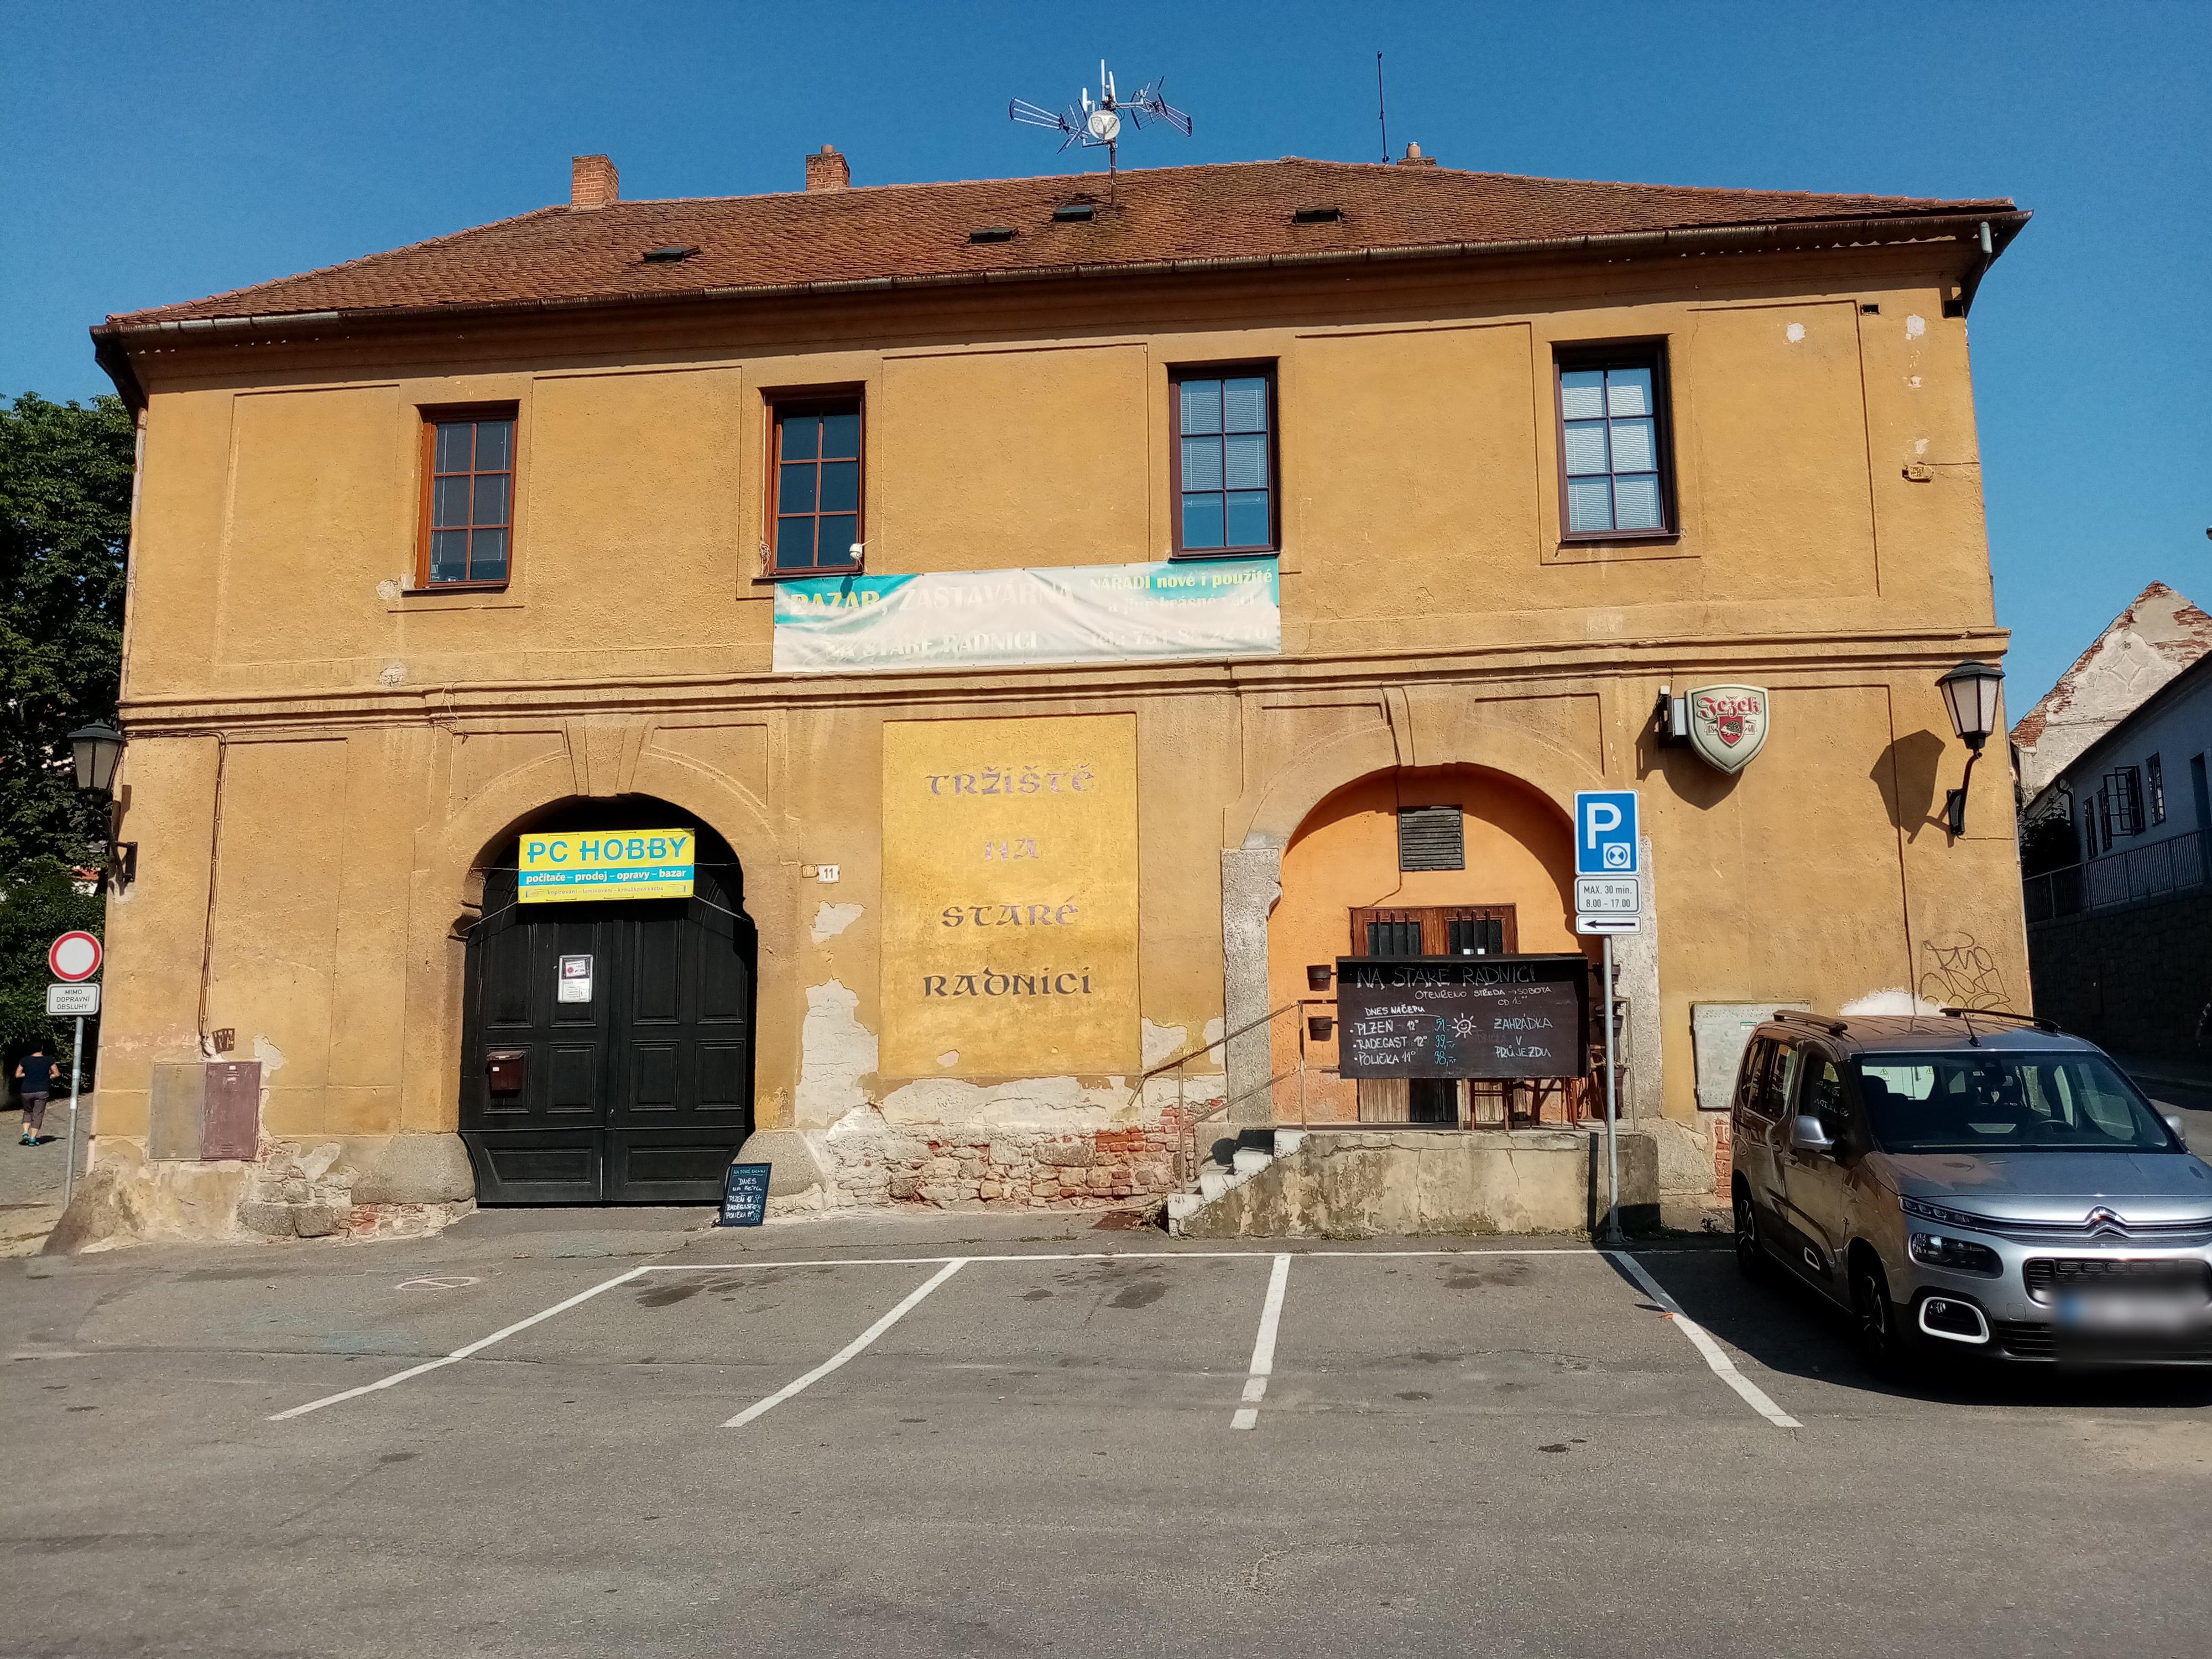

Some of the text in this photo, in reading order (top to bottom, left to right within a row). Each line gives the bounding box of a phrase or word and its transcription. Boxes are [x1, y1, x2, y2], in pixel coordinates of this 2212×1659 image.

[1090, 569, 1272, 590] NÁŘADÍ nové i použité
[1243, 624, 1268, 640] 70
[943, 631, 1037, 653] RADNICI
[1697, 695, 1761, 720] Ježek
[924, 763, 1095, 795] TRŽIŠTĚ
[1587, 803, 1622, 849] P
[528, 837, 686, 863] PC HOBBY
[985, 839, 1039, 860] NA
[526, 872, 566, 884] počítače
[575, 871, 607, 882] prodej
[617, 870, 650, 881] opravy
[659, 869, 686, 878] bazar
[824, 868, 833, 879] 11
[1584, 885, 1632, 894] MAX. 30 min.
[941, 896, 1078, 927] STARÉ
[1586, 899, 1601, 907] 8.00
[1611, 899, 1630, 907] 17.00
[924, 966, 1093, 997] RADNICI
[1357, 964, 1536, 990] NA STARÉ RADNICI
[1474, 988, 1505, 997] STŘEDA
[1517, 986, 1552, 995] SOBOTA
[1364, 1006, 1388, 1016] DNES
[1354, 1019, 1394, 1036] PLZEŇ
[1494, 1013, 1553, 1031] ZAHRÁDKA
[1356, 1036, 1407, 1050] RADEGAST
[1516, 1035, 1522, 1046] V
[1357, 1051, 1400, 1066] POLIČKA
[1495, 1045, 1552, 1059] PRŮJEZDU
